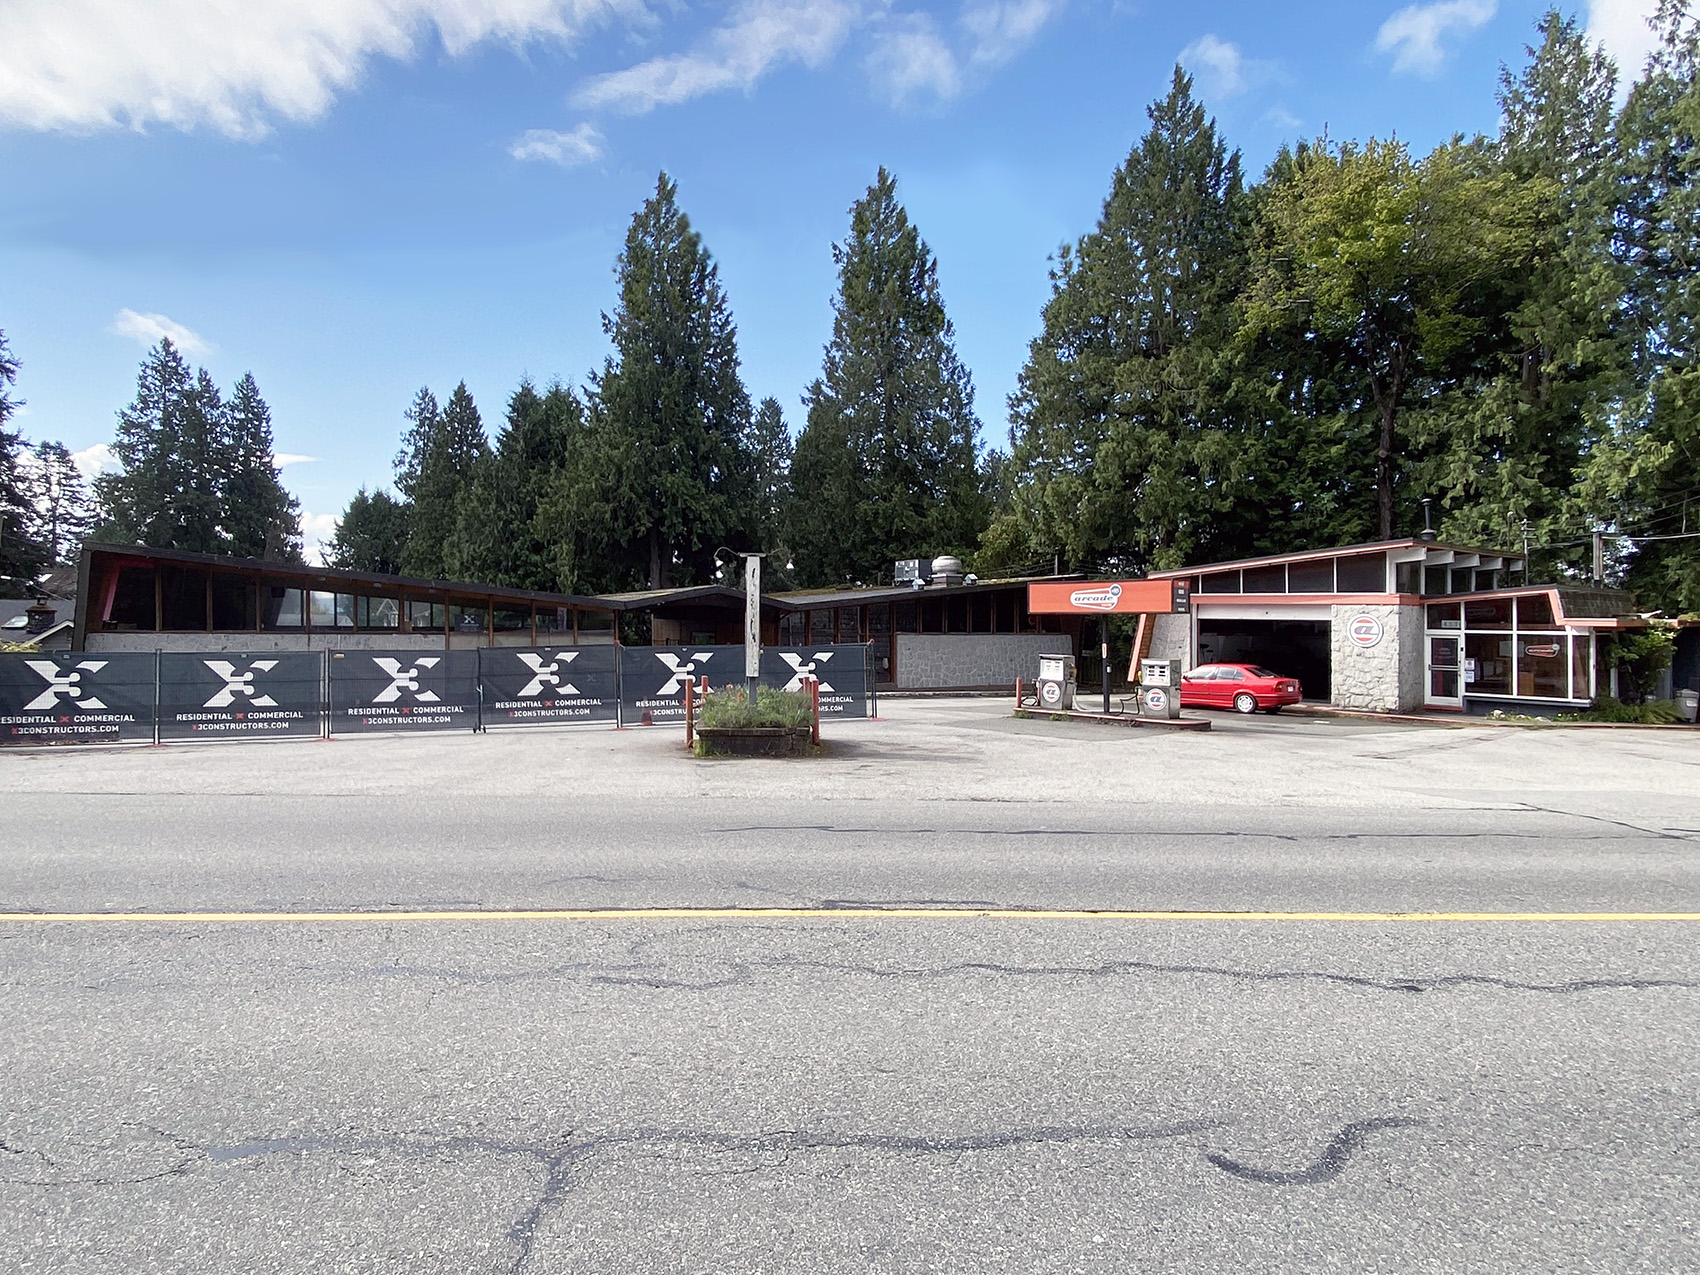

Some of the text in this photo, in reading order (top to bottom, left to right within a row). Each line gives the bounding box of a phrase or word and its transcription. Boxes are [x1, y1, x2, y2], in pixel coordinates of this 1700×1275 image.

[495, 700, 543, 709] RESIDENTIAL
[554, 698, 602, 707] COMMERCIAL
[635, 699, 680, 708] RESIDENTIAL
[347, 706, 400, 715] RESIDENTIAL
[412, 705, 464, 714] COMMERCIAL
[1, 715, 56, 724] ESIDENTIAL
[73, 714, 136, 723] COMMERCIAL
[176, 712, 233, 721] RESIDENTIAL
[247, 711, 304, 719] COMMERCIAL
[362, 715, 451, 726] X3CONSTRUCTORS.COM
[11, 724, 119, 735] X3CONSTRUCTORS.COM
[192, 721, 289, 731] X3CONSTRUCTORS.COM
